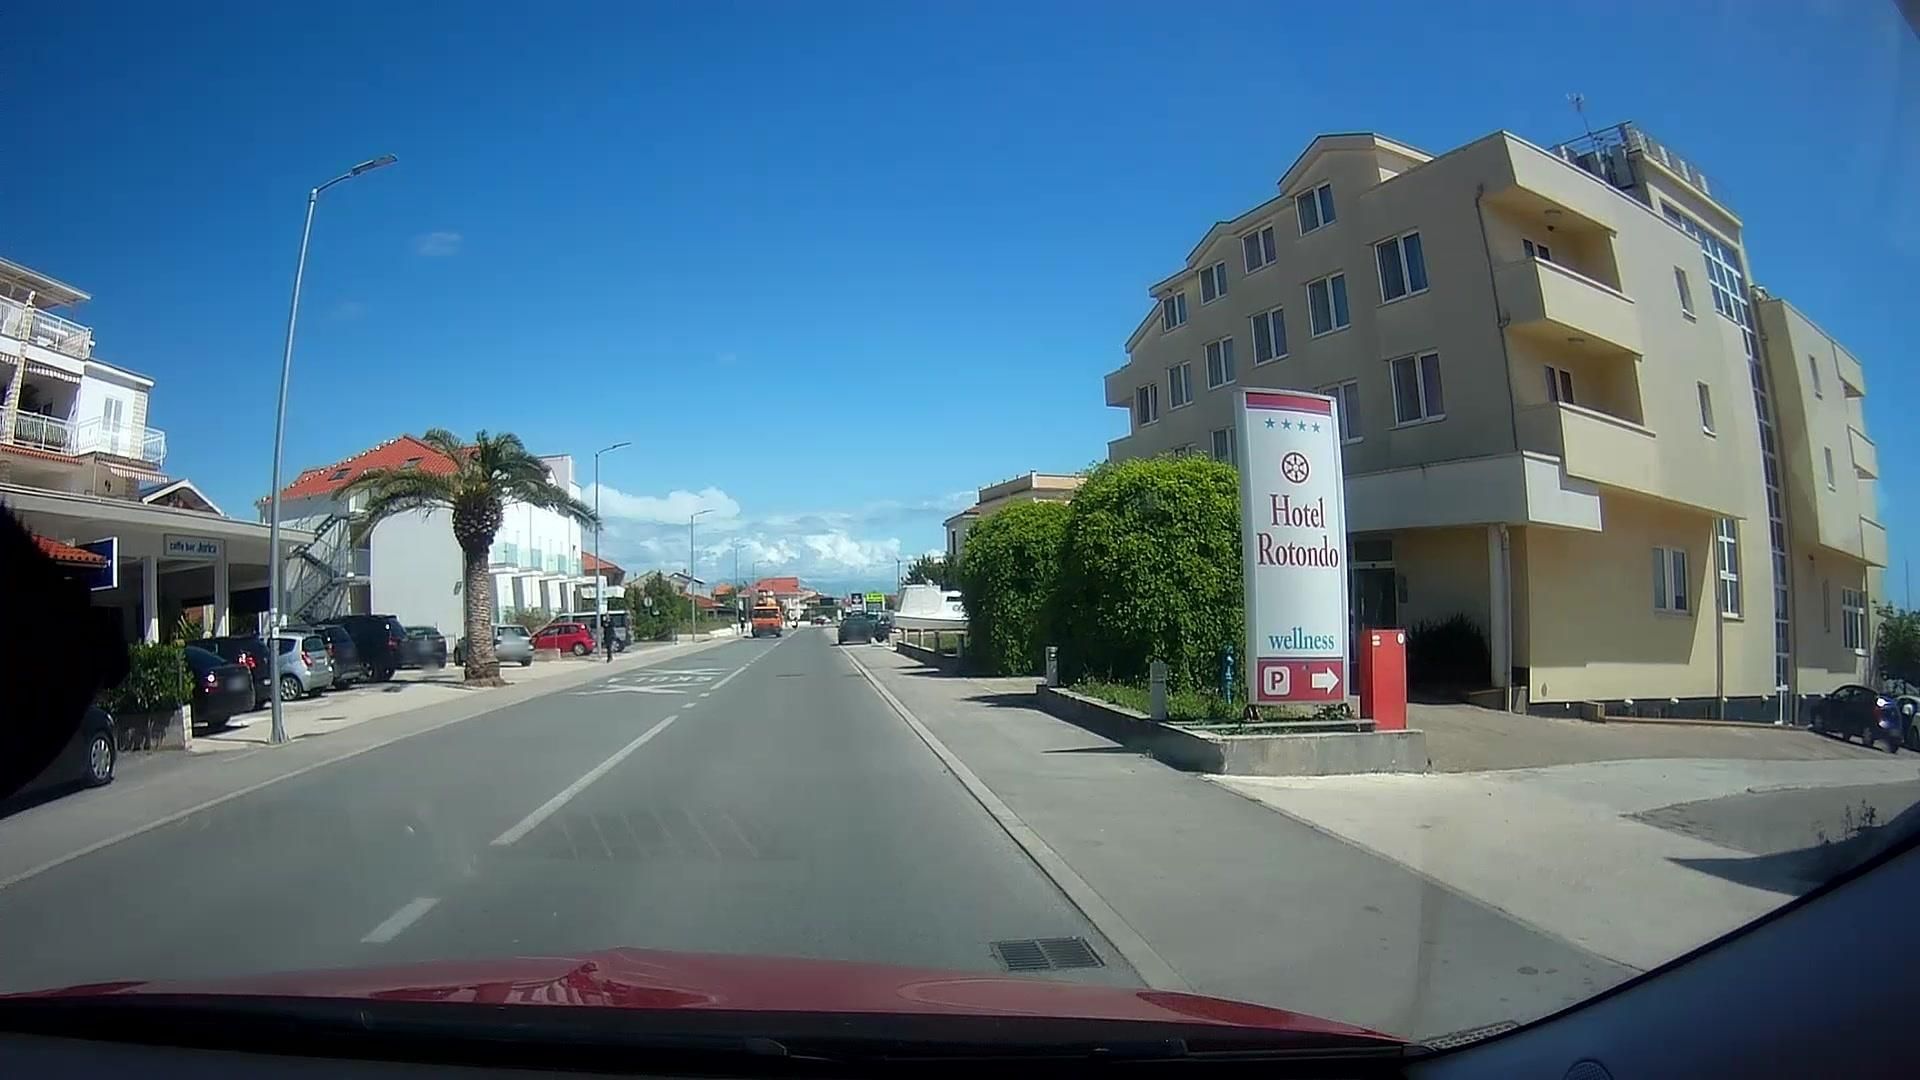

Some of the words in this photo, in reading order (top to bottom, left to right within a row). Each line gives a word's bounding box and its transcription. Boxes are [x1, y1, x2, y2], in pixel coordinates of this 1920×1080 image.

[1270, 494, 1326, 528] Hotel
[1257, 532, 1338, 567] Rotondo
[1268, 626, 1335, 650] wellness
[1271, 671, 1285, 691] P
